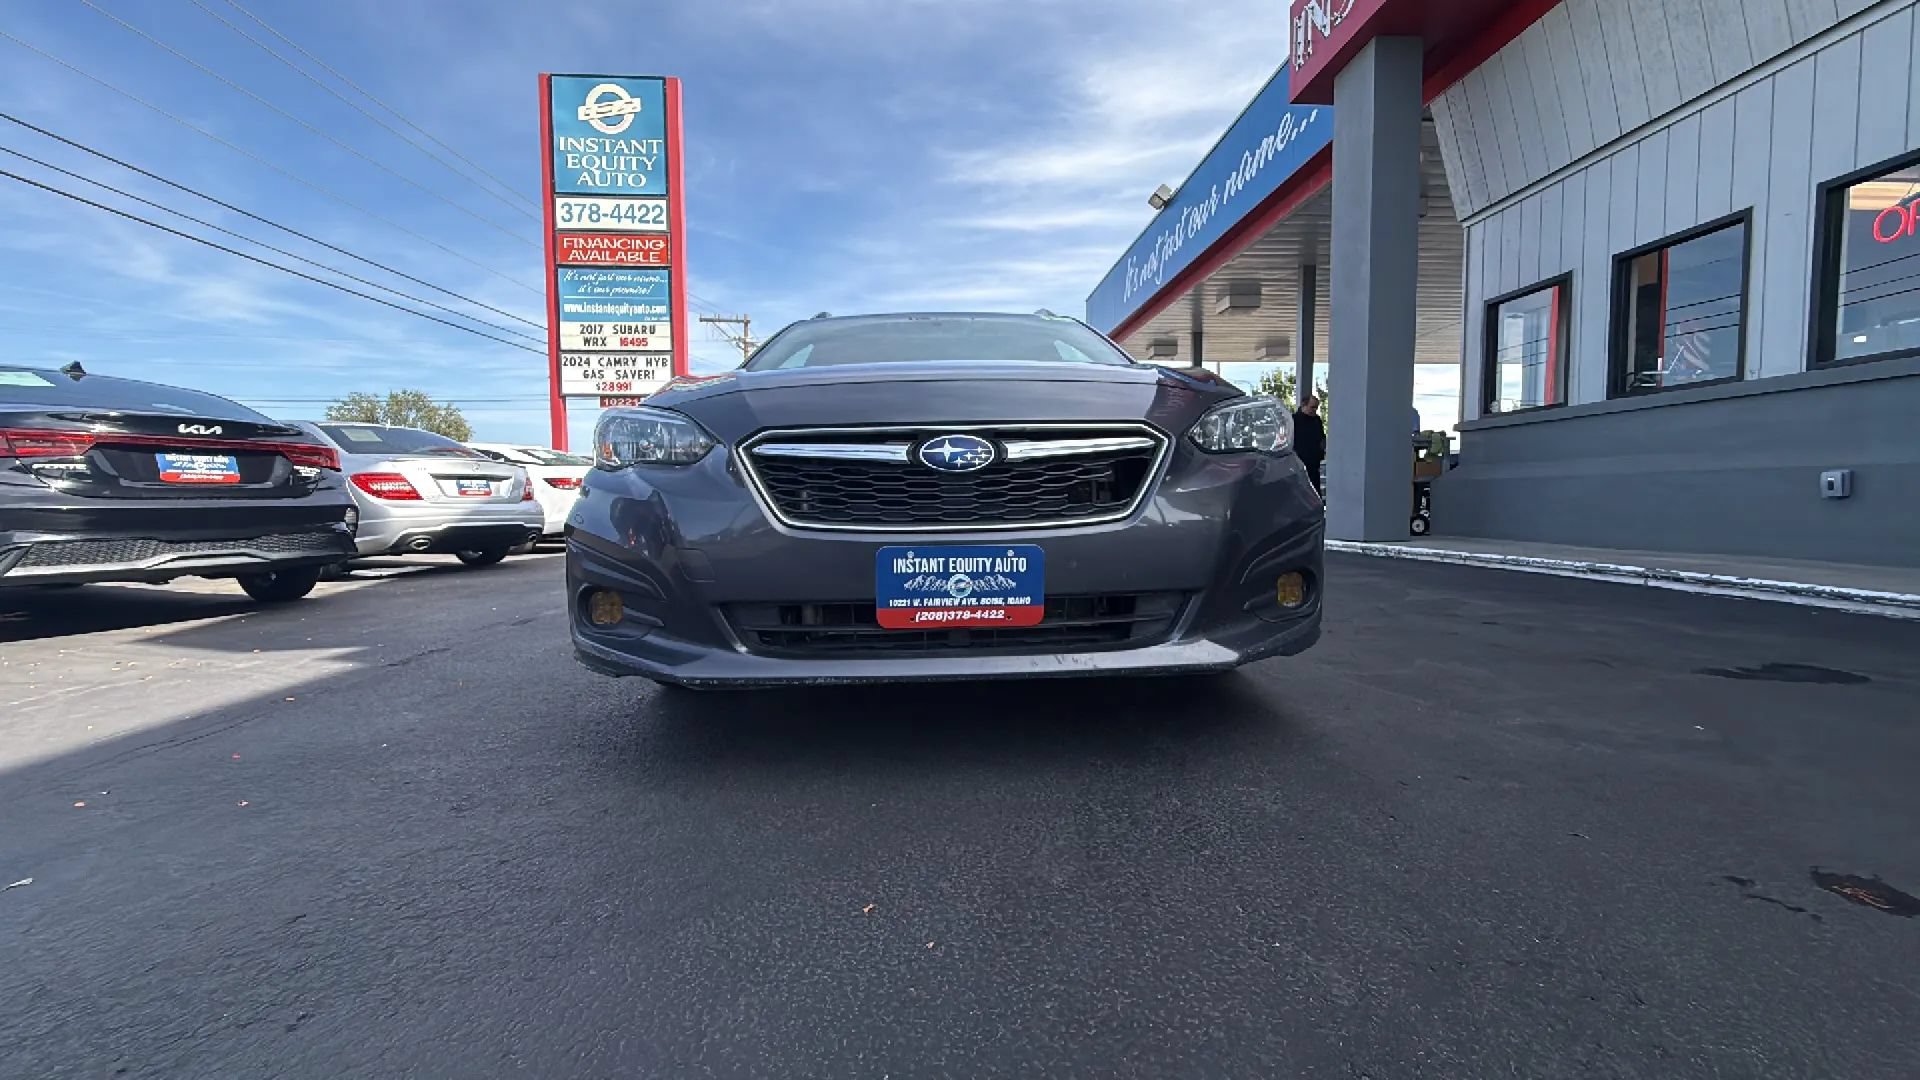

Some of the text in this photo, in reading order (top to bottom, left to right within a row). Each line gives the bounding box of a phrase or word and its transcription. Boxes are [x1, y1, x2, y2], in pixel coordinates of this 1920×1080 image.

[559, 136, 662, 154] INSTANT
[566, 153, 657, 173] EQUITY
[576, 171, 647, 187] AUTO
[560, 202, 665, 225] 378-4422
[1140, 235, 1164, 287] not
[1155, 206, 1193, 285] just
[1188, 184, 1220, 239] our
[563, 237, 666, 250] FINANCING
[568, 249, 661, 262] AVAILABLE
[610, 283, 655, 297] promise!
[563, 301, 667, 316] www.instantequityauto.com
[579, 324, 656, 335] 2017 SUBARU
[583, 336, 649, 347] WRX 16495
[562, 356, 669, 367] 2024 CAMRY HYB
[583, 369, 655, 380] GAS SAVER!
[177, 423, 223, 435] KIA
[893, 557, 1027, 574] INSTANT EQUITY AUTO
[889, 599, 911, 607] 10221
[923, 598, 960, 607] FAIRVIEW
[961, 597, 978, 606] AVE.
[980, 597, 1005, 606] BOISE,
[1006, 596, 1031, 605] IDAHO
[915, 609, 1005, 622] (208)378-4422
